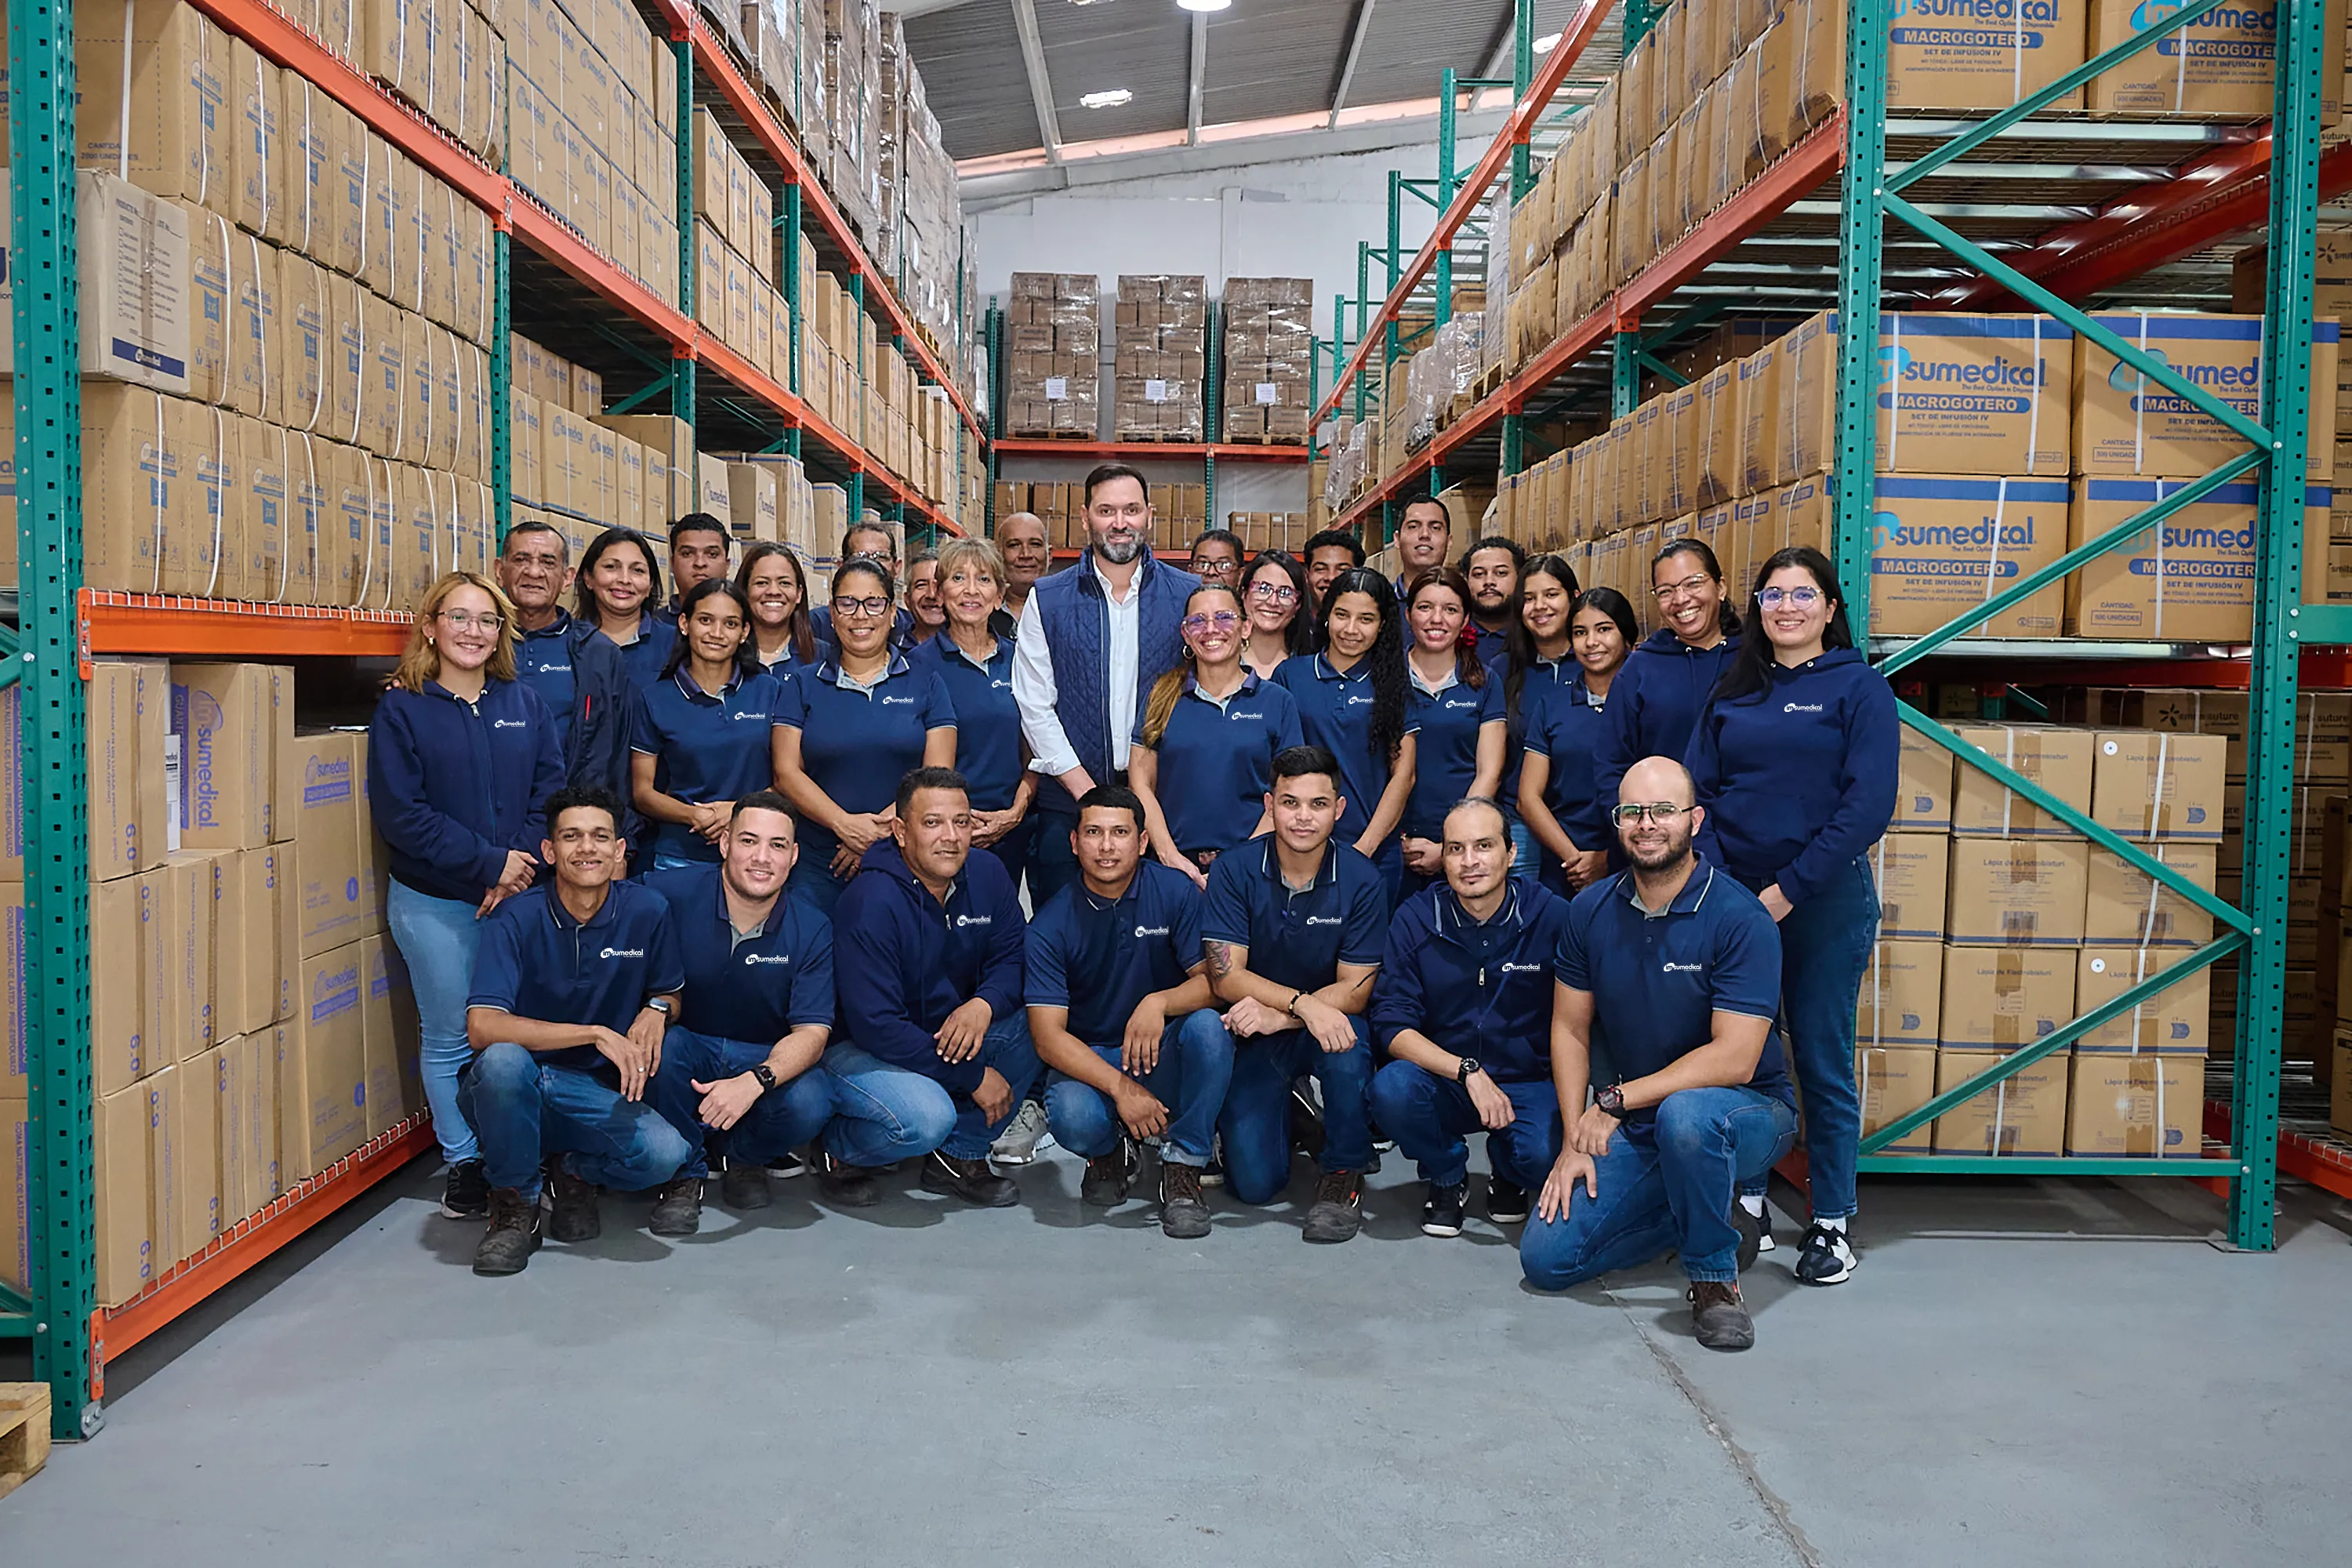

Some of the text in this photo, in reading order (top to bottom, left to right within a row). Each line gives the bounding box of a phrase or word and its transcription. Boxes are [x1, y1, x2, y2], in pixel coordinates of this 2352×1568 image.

[1904, 31, 2030, 46] MACROGOTERO
[2171, 42, 2276, 57] MACROGOTE
[1897, 396, 2017, 412] MACROGOTERO
[2162, 521, 2255, 548] sumed
[2143, 561, 2255, 576] MACROGOTER
[5, 750, 11, 759] DE
[125, 822, 137, 858] 6.0
[8, 968, 15, 978] DE
[202, 1004, 211, 1038] 6.0
[130, 1034, 140, 1071] 6.0
[209, 1196, 219, 1232] 6.0
[140, 1240, 151, 1279] 6.0
